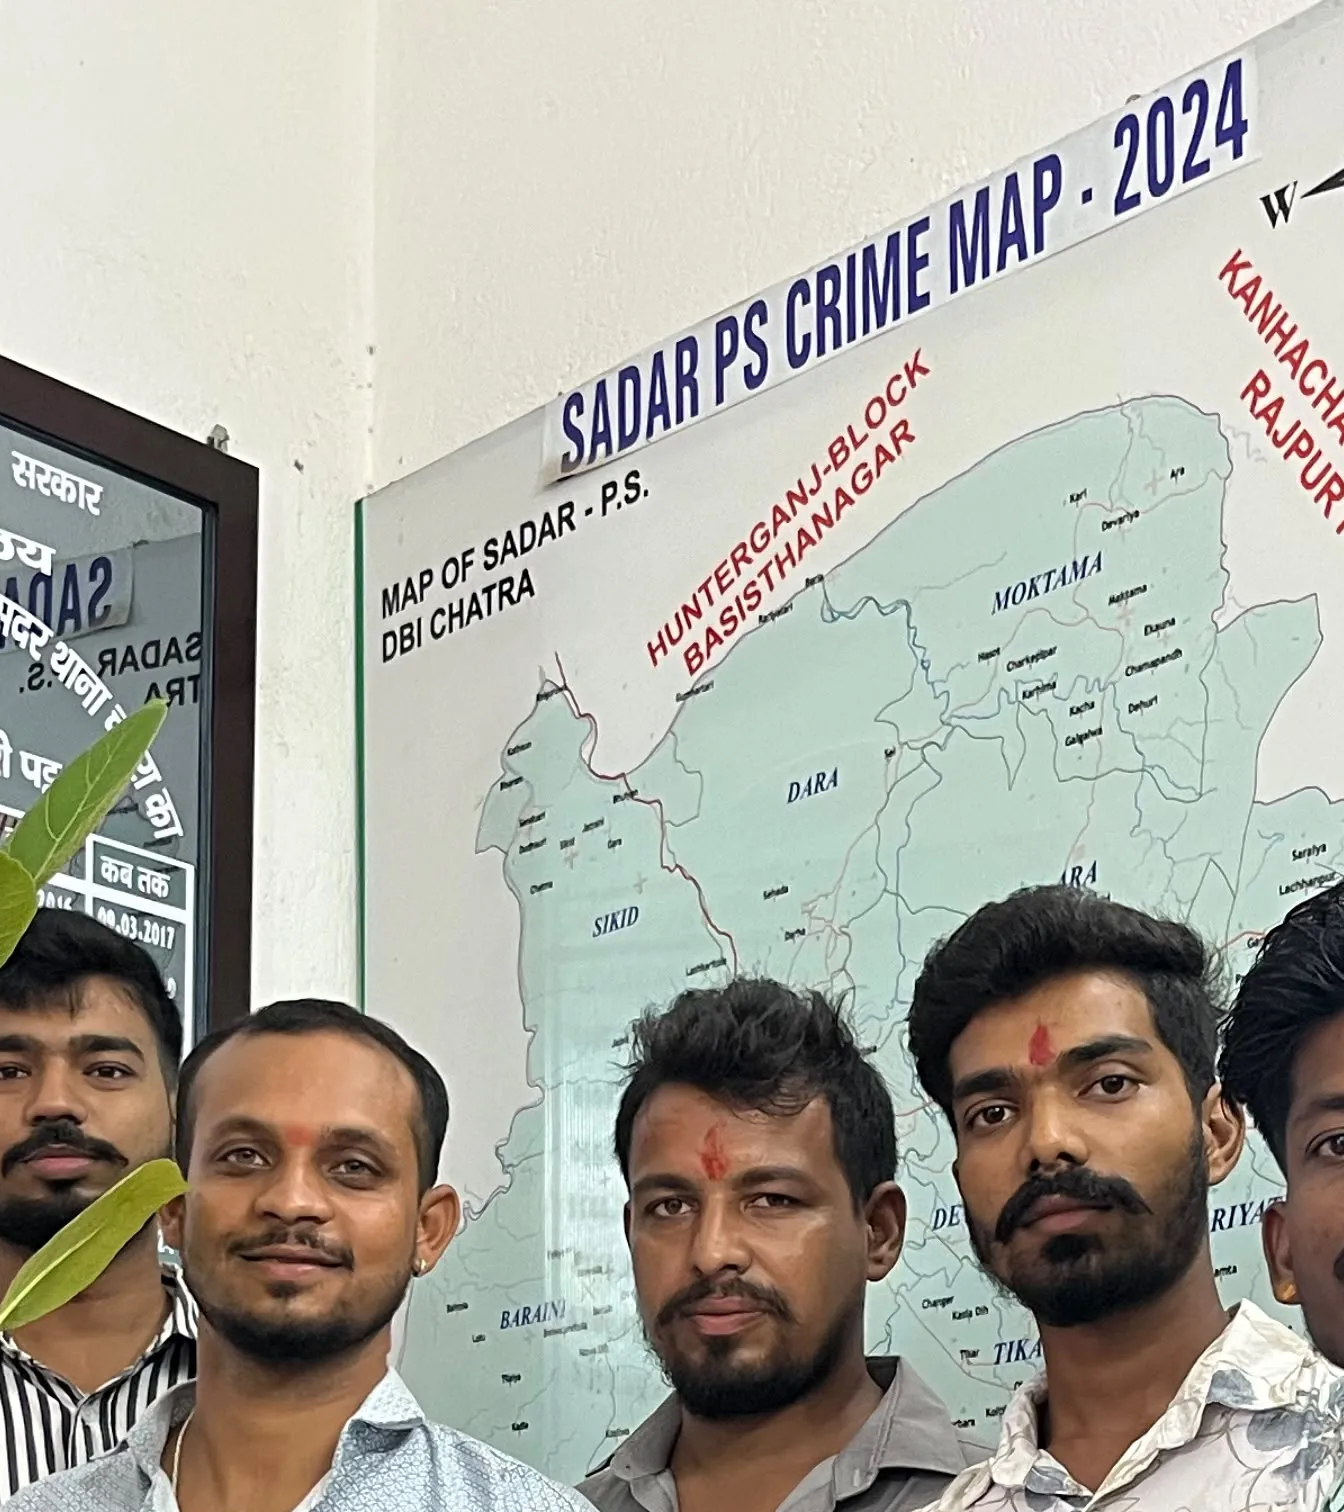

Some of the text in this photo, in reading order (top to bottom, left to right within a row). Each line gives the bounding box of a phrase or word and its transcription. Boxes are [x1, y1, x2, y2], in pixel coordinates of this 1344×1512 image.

[1259, 180, 1299, 229] W
[560, 335, 700, 474] SADAR
[715, 299, 769, 407] PS
[785, 216, 932, 370] CRIME
[949, 153, 1063, 295] MAP
[1113, 57, 1249, 219] 2024
[11, 450, 102, 517] सरकार
[646, 348, 931, 667] HUNTERGANJ-BLOCK
[380, 569, 435, 619] MAP
[441, 552, 477, 591] OF
[482, 500, 577, 571] SADAR
[600, 469, 650, 519] P.S.
[682, 417, 916, 676] BASISTHANAGAR
[381, 569, 536, 663] DBI CHATRA
[991, 551, 1102, 616] MOKTAMA
[50, 641, 113, 717] थाना
[145, 787, 184, 840] का
[787, 767, 839, 805] DARA
[592, 905, 640, 938] SIKID
[500, 1297, 567, 1330] BARAINI
[993, 1337, 1043, 1366] TIKA
